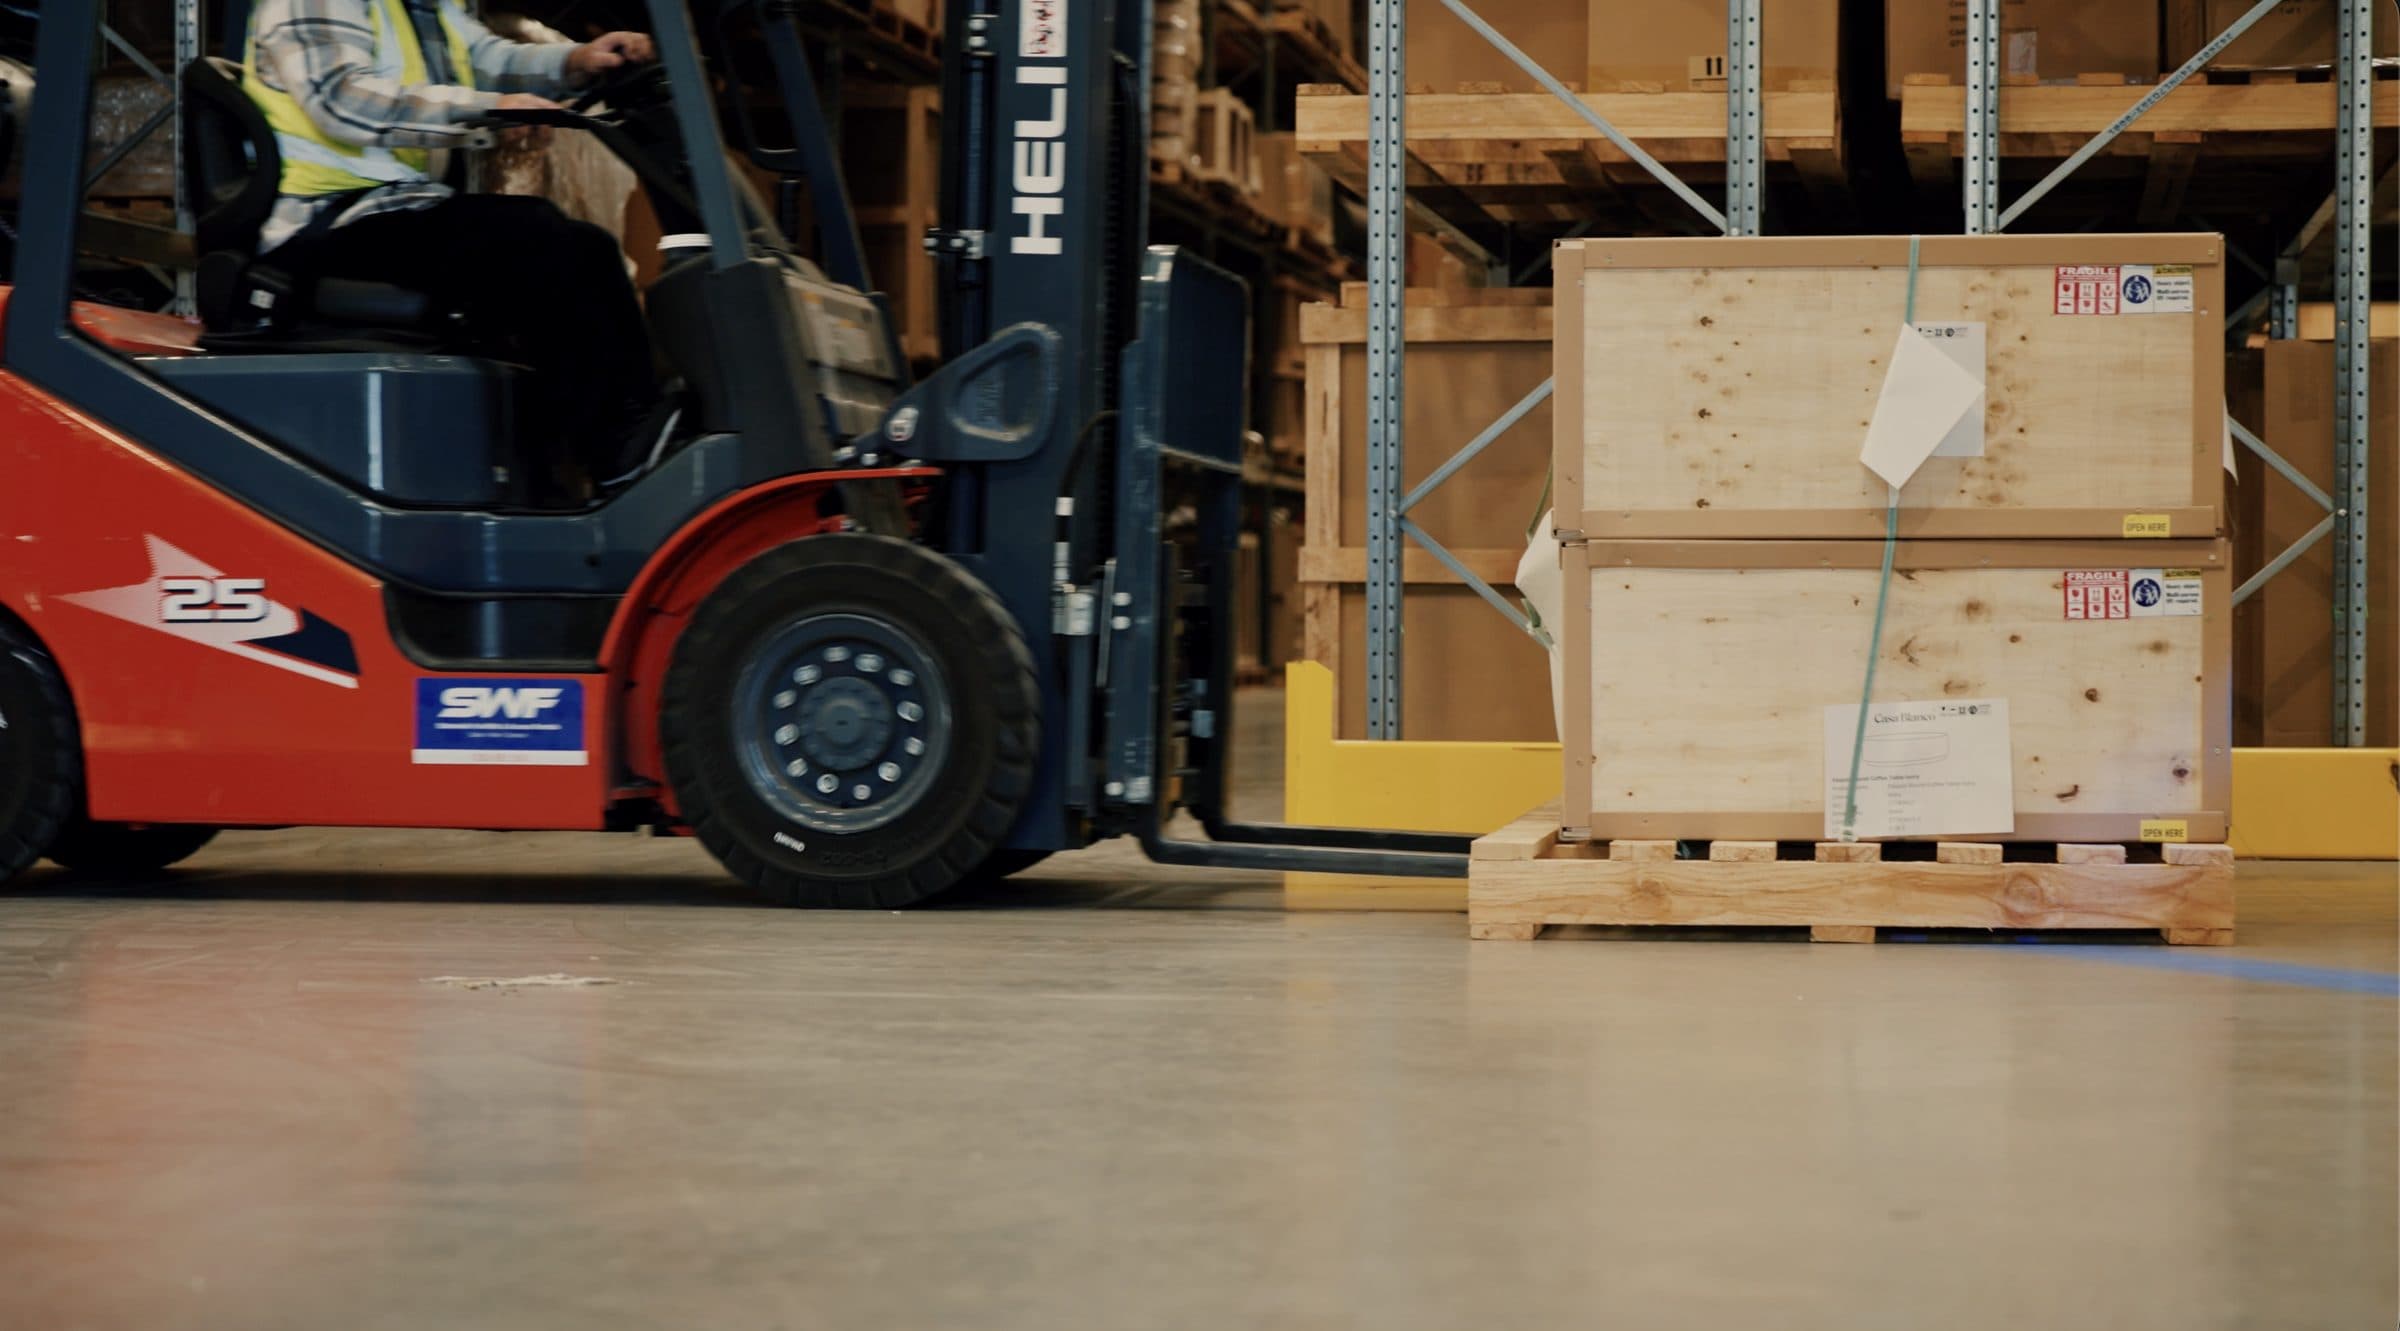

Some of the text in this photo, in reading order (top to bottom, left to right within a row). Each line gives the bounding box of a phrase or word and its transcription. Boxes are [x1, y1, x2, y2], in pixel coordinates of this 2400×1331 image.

[1010, 66, 1068, 255] HELI
[2058, 266, 2118, 276] FRAGILE
[2126, 522, 2167, 532] OPEN HERE
[2067, 572, 2125, 580] FRAGILE
[162, 578, 267, 623] 25
[436, 687, 564, 719] SWF
[1873, 710, 1936, 724] Casa Blanco
[2143, 828, 2185, 838] OPEN HERE
